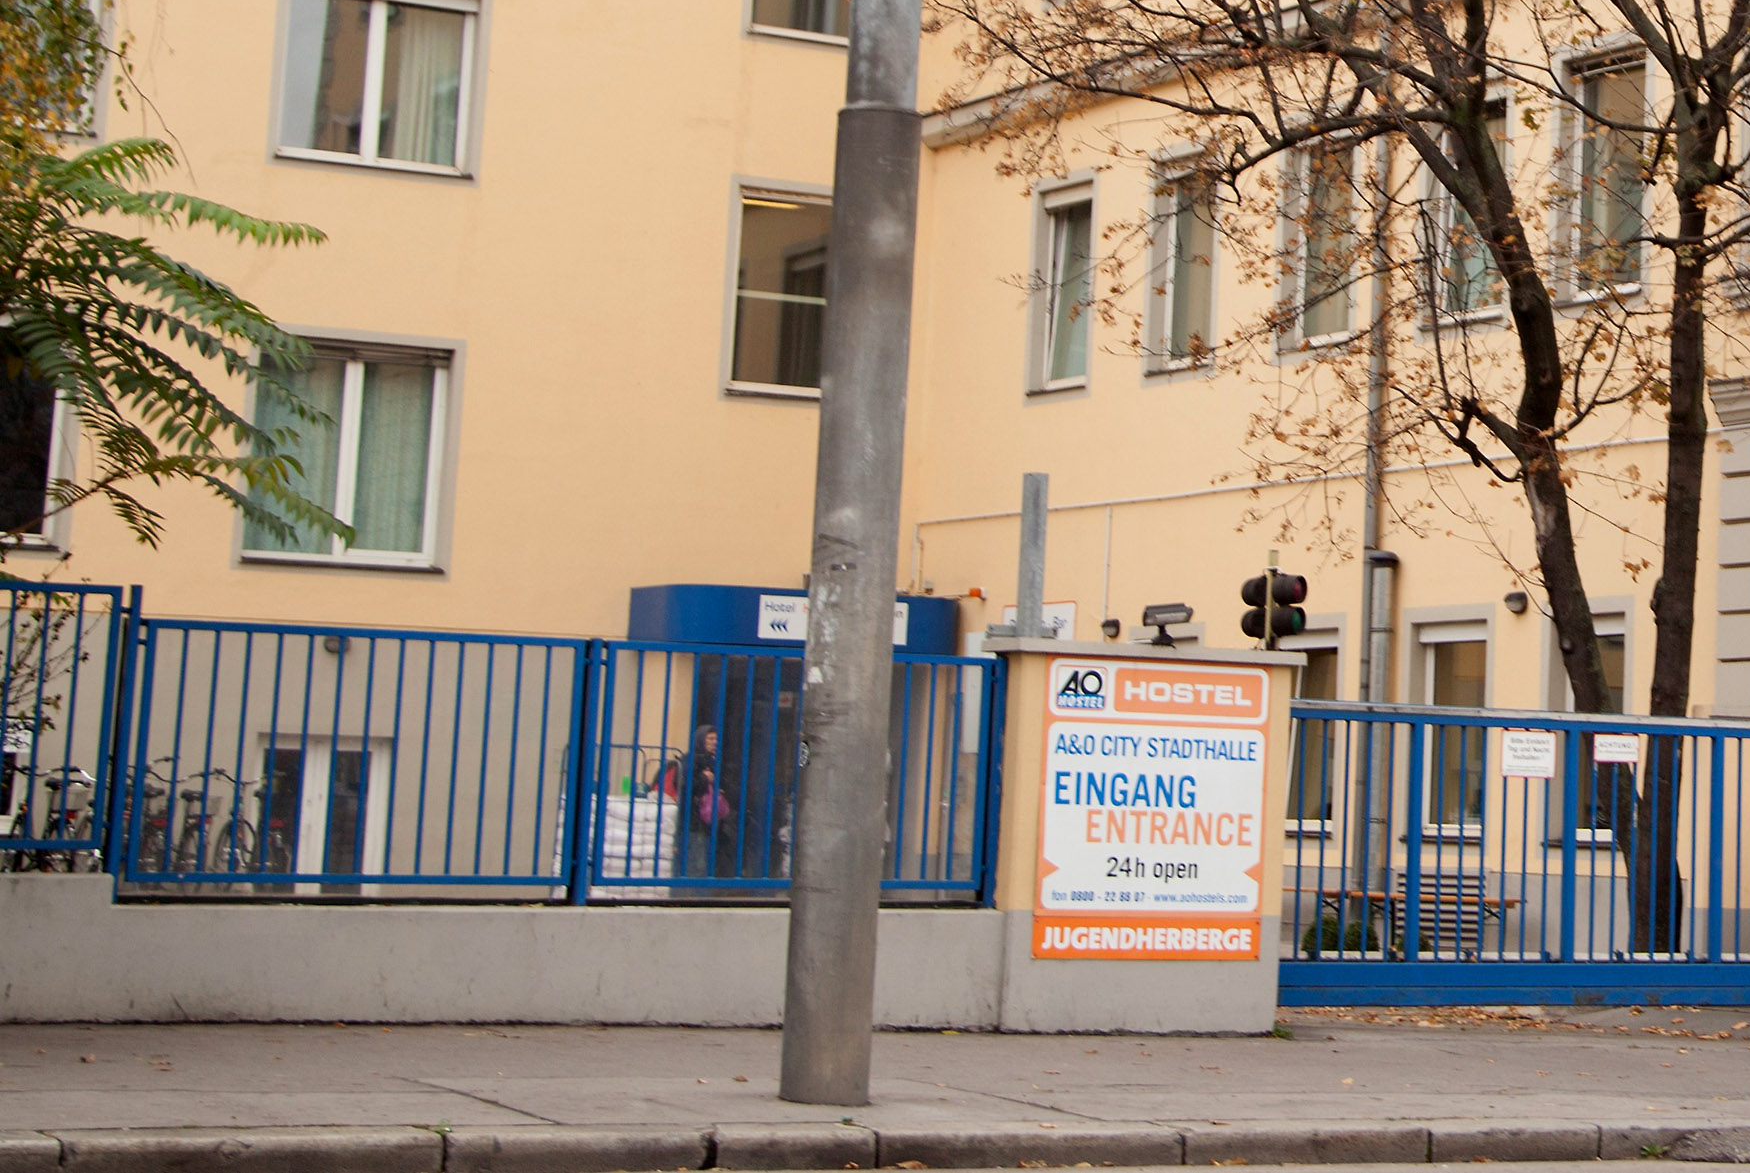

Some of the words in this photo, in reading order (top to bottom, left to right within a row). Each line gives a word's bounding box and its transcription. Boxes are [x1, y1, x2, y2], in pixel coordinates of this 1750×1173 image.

[764, 600, 796, 614] Hotel
[1057, 694, 1105, 709] HOSTEL
[1124, 680, 1252, 707] HOSTEL
[1055, 733, 1096, 756] A&O
[1101, 735, 1142, 758] CITY
[1146, 737, 1257, 762] STADTHALLE
[1055, 771, 1197, 808] EINGANG
[1086, 809, 1254, 847] ENTRANCE
[1106, 856, 1146, 878] 24h
[1153, 859, 1199, 883] open
[1041, 926, 1252, 950] JUGENDHERBERGE
